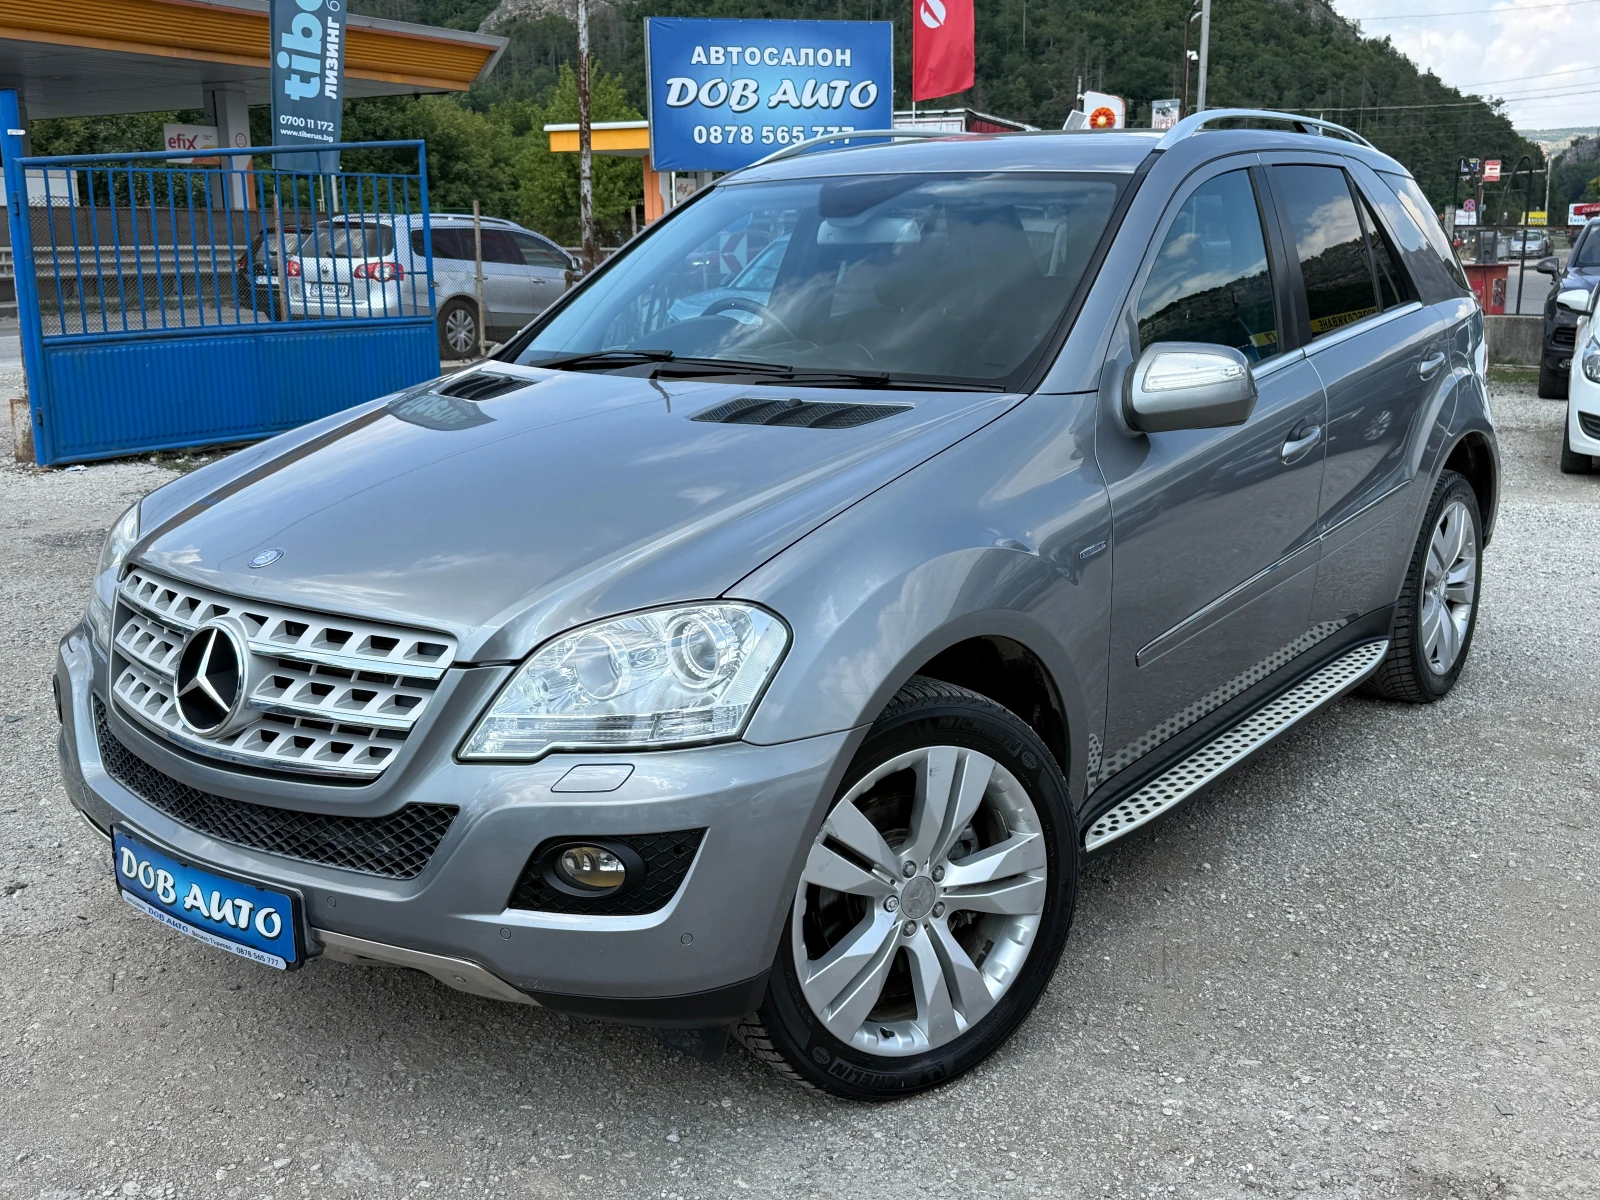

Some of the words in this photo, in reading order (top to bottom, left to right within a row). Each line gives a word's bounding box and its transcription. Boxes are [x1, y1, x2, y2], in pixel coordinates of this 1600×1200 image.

[690, 45, 852, 67] АВТОСАЛОН
[665, 77, 760, 113] DOB
[767, 78, 879, 109] AUTO
[280, 115, 305, 127] 0700
[306, 119, 315, 129] 11
[316, 120, 335, 132] 172
[167, 133, 199, 150] efix
[280, 128, 334, 143] www.tiberus.bg
[692, 125, 755, 145] 0878
[760, 125, 806, 145] 565
[120, 846, 177, 905] DOB
[184, 882, 283, 939] AUTO
[148, 906, 165, 922] DOB
[166, 918, 189, 933] AUTO
[236, 946, 253, 958] 0878
[253, 952, 266, 963] 565
[267, 956, 279, 967] 777
